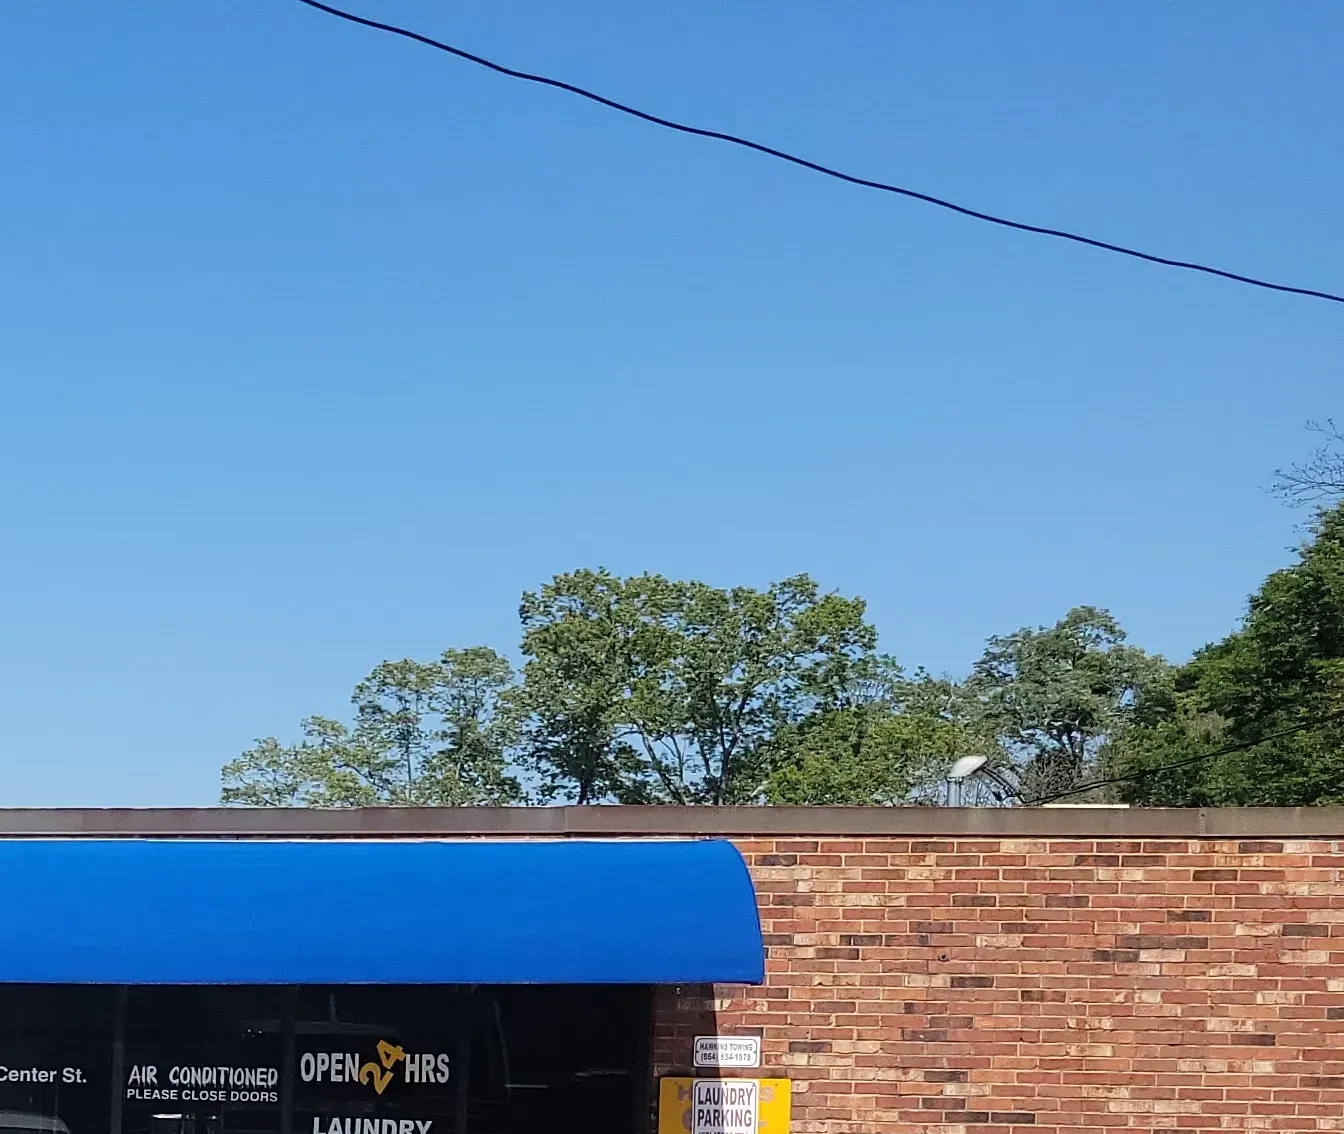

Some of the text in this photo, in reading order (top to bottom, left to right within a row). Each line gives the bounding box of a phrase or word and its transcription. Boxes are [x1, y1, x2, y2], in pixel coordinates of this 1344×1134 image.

[62, 1067, 87, 1083] St.
[128, 1064, 278, 1088] AIR CONDITIONED
[300, 1039, 450, 1095] OPEN 24 HRS
[127, 1089, 278, 1102] PLEASE CLOSE DOORS
[697, 1087, 753, 1106] LAUNDRY
[697, 1109, 752, 1127] PARKING
